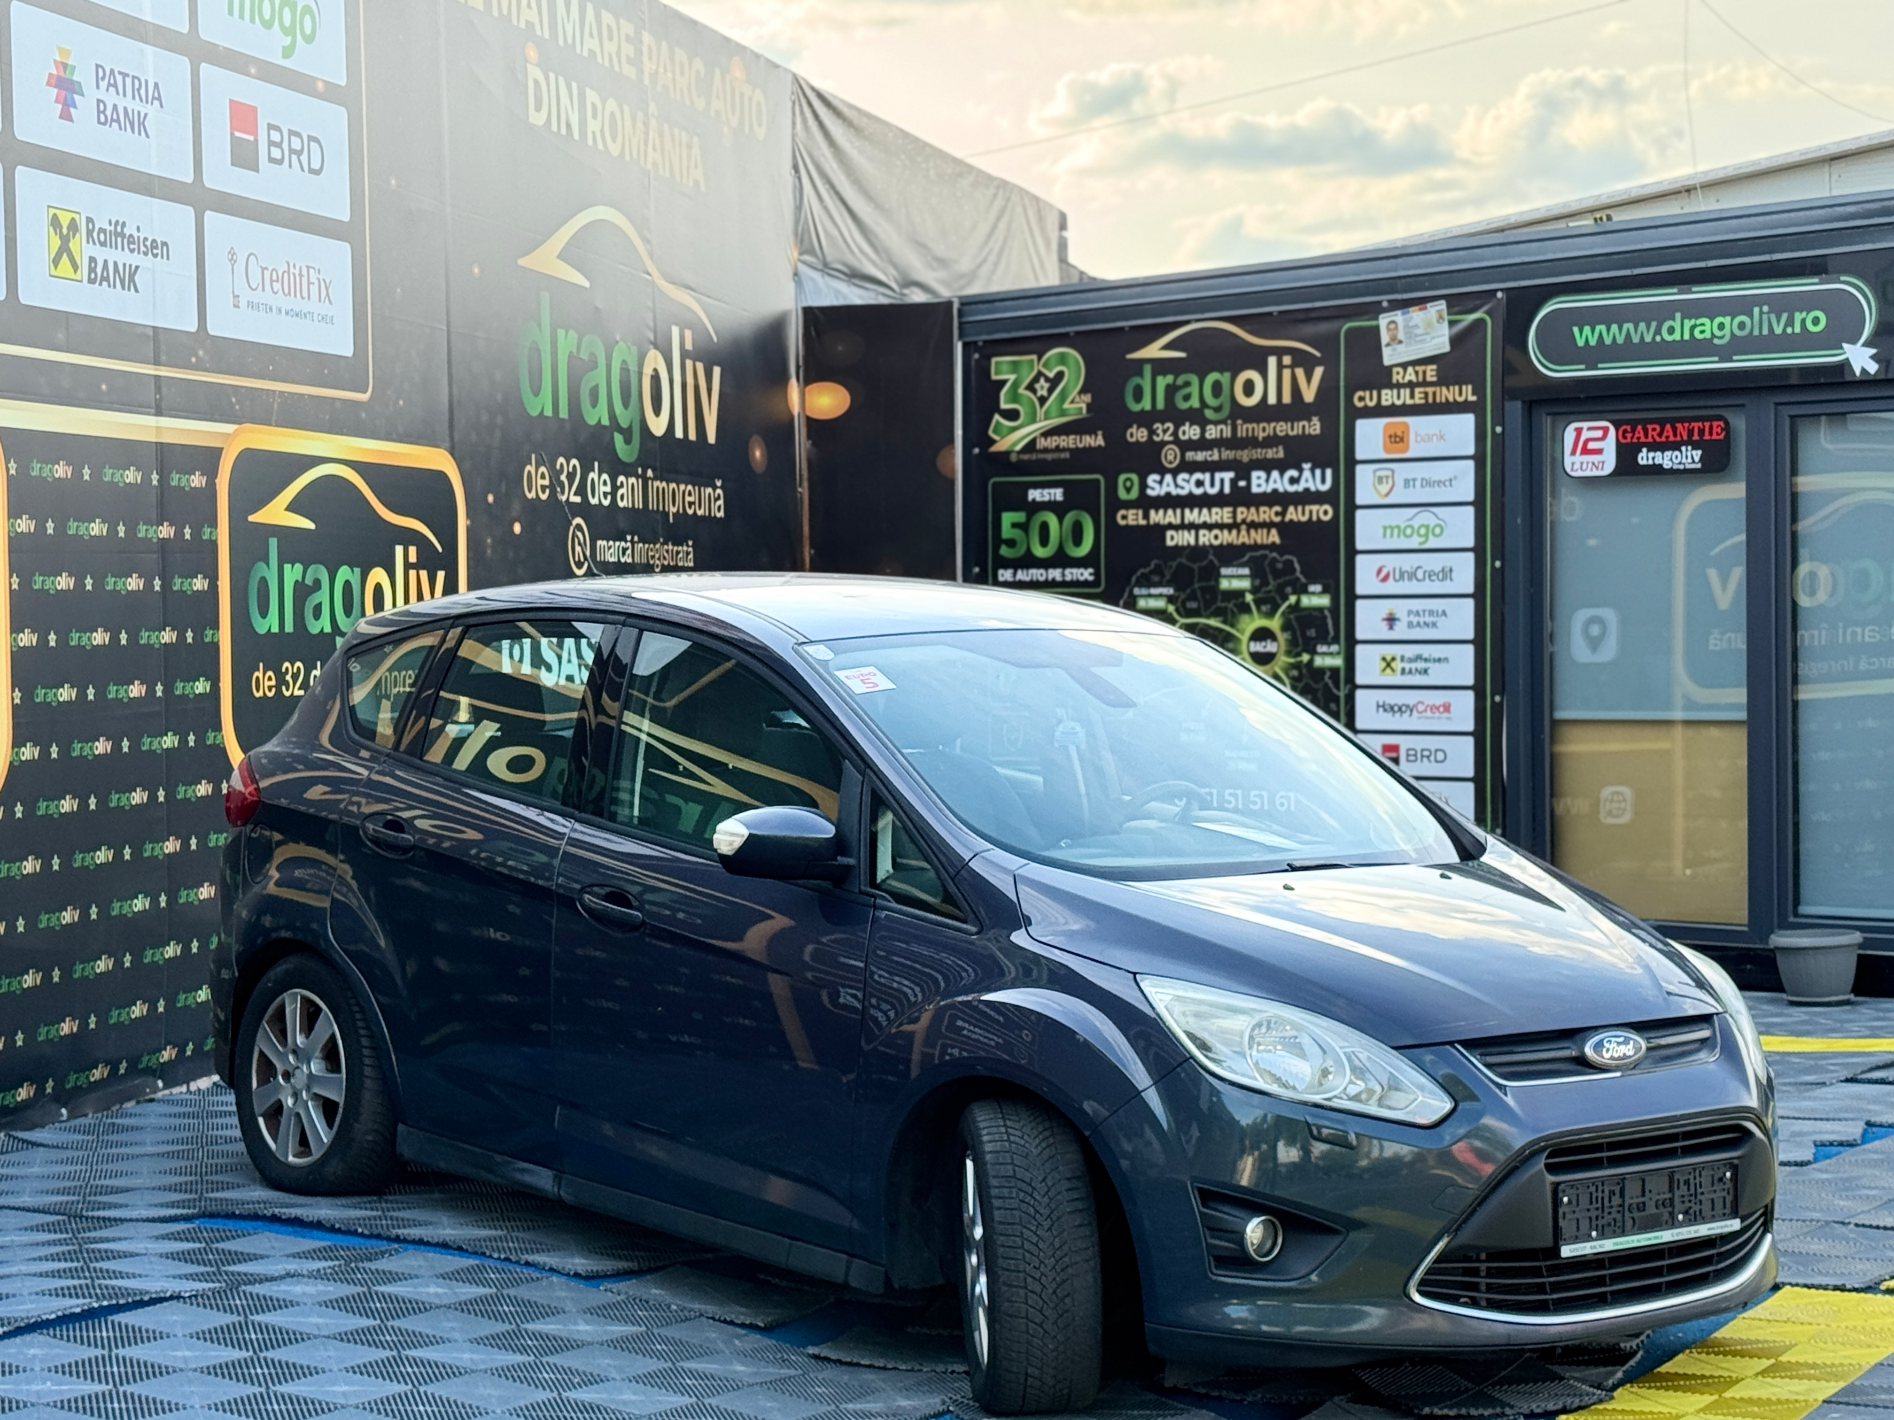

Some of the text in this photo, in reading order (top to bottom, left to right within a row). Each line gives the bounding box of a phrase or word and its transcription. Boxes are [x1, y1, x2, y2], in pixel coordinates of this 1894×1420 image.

[556, 0, 636, 79] MARE
[641, 29, 706, 112] PARC
[710, 67, 767, 141] AUTO
[94, 62, 164, 109] PATRIA
[95, 99, 150, 139] BANK
[526, 62, 706, 192] DIN ROMÂNIA
[266, 122, 325, 177] BRD
[85, 215, 170, 261] Raiffeisen
[86, 256, 140, 293] BANK
[245, 252, 333, 306] CreditFix
[247, 299, 273, 314] PRIETEN
[285, 307, 315, 322] MOMENTE
[317, 313, 335, 325] CHEIE
[1571, 305, 1827, 347] www.dragoliv.ro
[519, 290, 721, 463] dragoliv
[1392, 365, 1437, 384] RATE
[1074, 393, 1092, 404] ANI
[1124, 355, 1324, 421] dragoliv
[1353, 384, 1477, 408] CU BULETINUL
[1036, 431, 1105, 450] ÎMPREUNĂ
[1126, 416, 1321, 443] de 32 de ani împreună
[1388, 430, 1447, 444] tbi bank
[1569, 425, 1610, 456] 12
[1617, 421, 1726, 443] GARANTIE
[1185, 447, 1219, 462] marcă
[1220, 446, 1285, 464] înregistrată
[1570, 460, 1606, 472] LUNI
[1637, 445, 1702, 469] dragoliv
[30, 459, 207, 490] dragoliv dragoliv dragoliv
[1146, 471, 1235, 497] SASCUT
[1250, 463, 1332, 494] BACĂU
[1377, 475, 1391, 485] BT
[1404, 478, 1418, 489] BT
[523, 453, 724, 523] de 32 de ani împreună
[1028, 488, 1064, 502] PESTE
[1116, 504, 1333, 526] CEL MAI MARE PARC AUTO
[67, 518, 109, 539] dragoliv
[137, 522, 176, 542] dragoliv
[999, 509, 1095, 559] 500
[1165, 526, 1280, 547] DIN ROMÂNIA
[1382, 522, 1444, 546] mogo
[597, 535, 632, 563] marcă
[634, 535, 694, 572] înregistrată
[32, 572, 209, 595] dragoliv dragoliv dragoliv
[998, 567, 1095, 582] DE AUTO PE STOC
[1392, 565, 1453, 583] UniCredit
[1407, 609, 1448, 619] PATRIA
[1407, 620, 1439, 629] BANK
[69, 628, 111, 649] dragoliv
[139, 627, 178, 648] dragoliv
[1400, 654, 1449, 665] Raiffeisen
[1400, 667, 1430, 676] BANK
[34, 677, 211, 706] dragoliv dragoliv dragoliv
[252, 662, 276, 698] de
[282, 661, 305, 697] 32
[309, 661, 321, 687] d
[859, 677, 879, 689] 5
[1376, 700, 1452, 718] HappyCredit
[70, 737, 113, 760] dragoliv
[140, 732, 180, 754] dragoliv
[1405, 748, 1447, 764] BRD
[36, 780, 213, 818] dragoliv dragoliv dragoliv
[1223, 789, 1243, 809] 51
[1248, 790, 1268, 810] 51
[1275, 791, 1295, 812] 61
[72, 845, 114, 870] dragoliv
[143, 836, 182, 859] dragoliv
[38, 882, 216, 930] dragoliv dragoliv dragoliv
[72, 953, 115, 979] dragoliv
[143, 940, 183, 965] dragoliv
[37, 1017, 79, 1042] dragoliv
[108, 1000, 149, 1024] dragoliv
[1603, 1037, 1635, 1059] Ford
[65, 1063, 111, 1089] dragoliv
[138, 1045, 179, 1070] dragoliv
